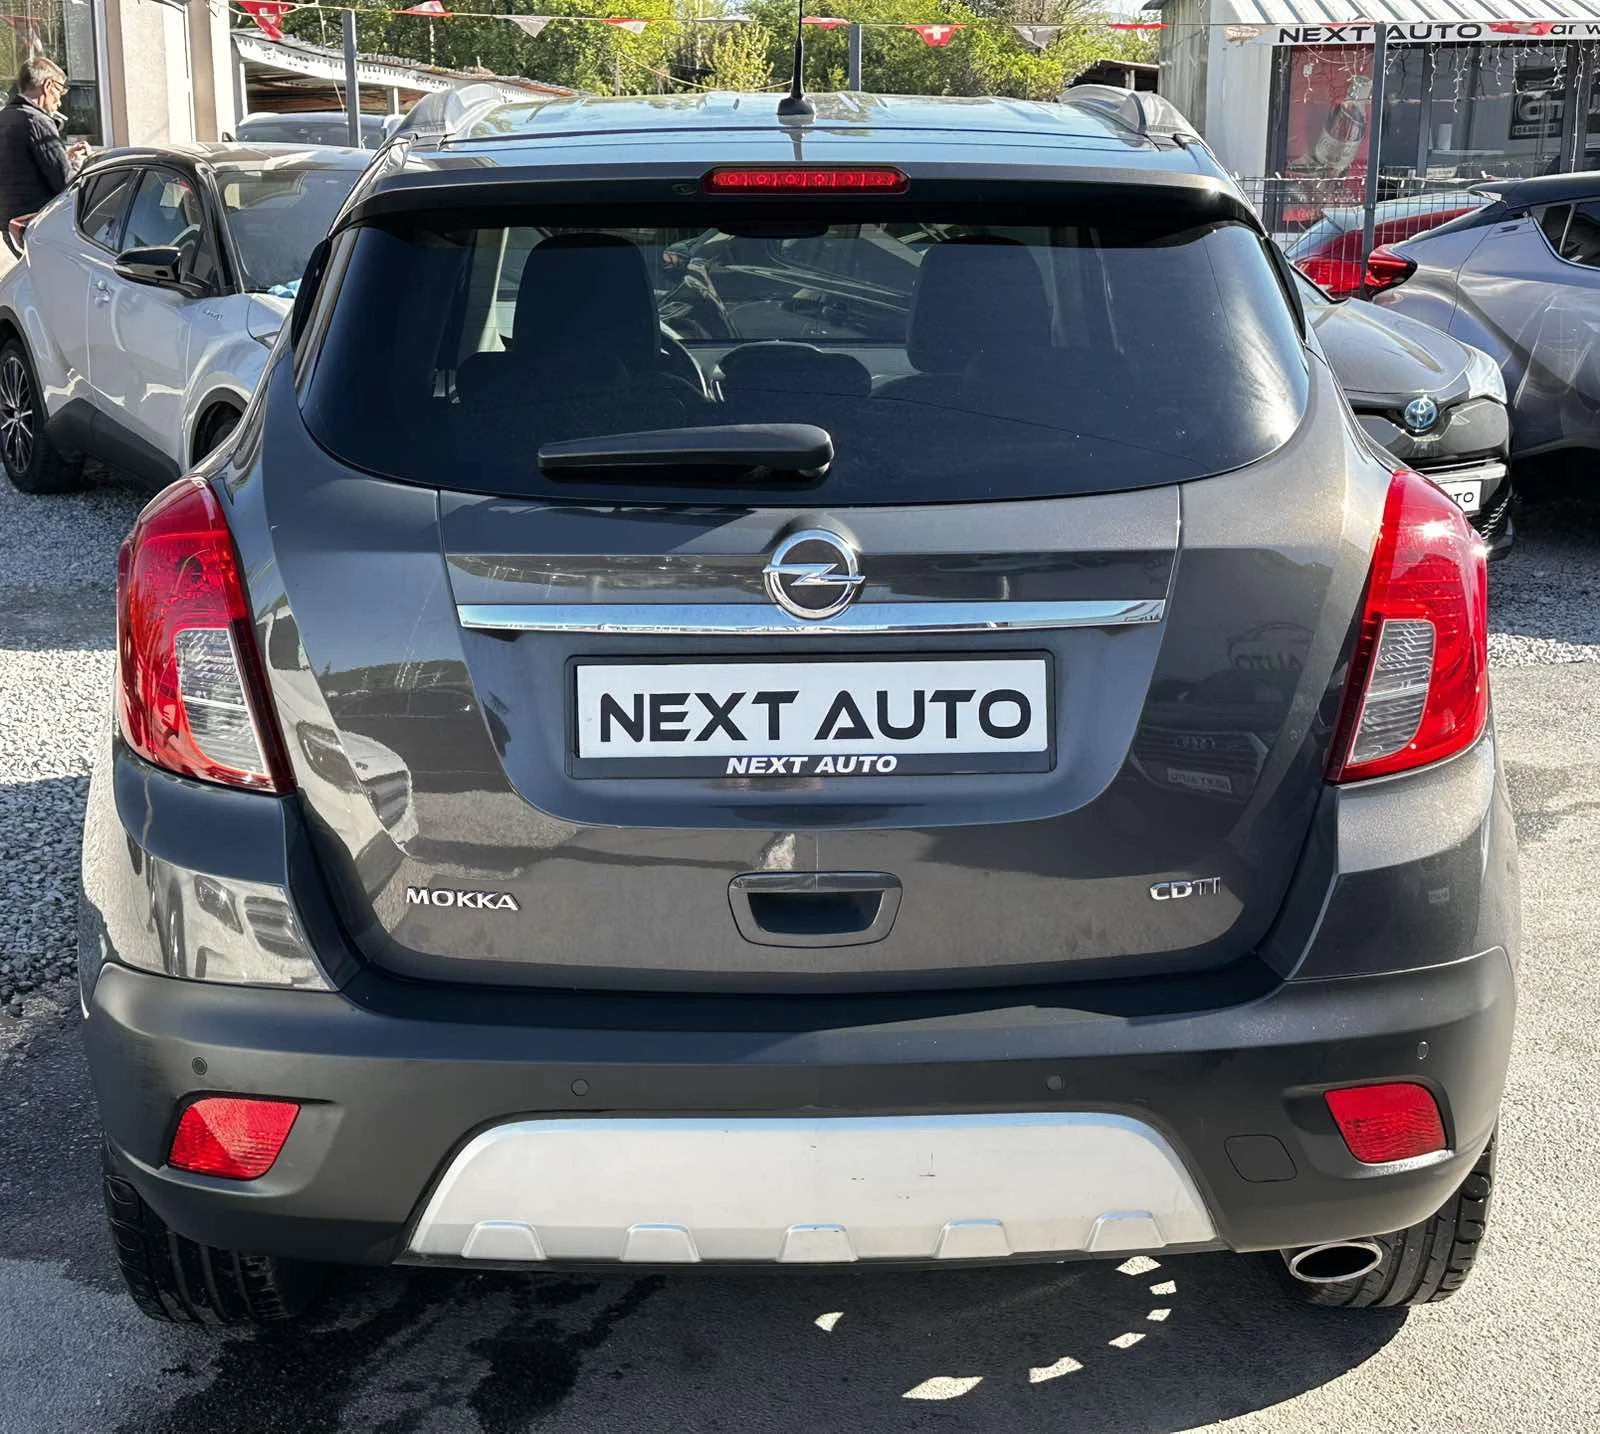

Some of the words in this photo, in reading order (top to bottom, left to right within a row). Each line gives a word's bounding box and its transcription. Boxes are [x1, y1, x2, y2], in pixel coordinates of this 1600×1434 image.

[1279, 26, 1371, 43] NEXT
[1386, 24, 1482, 40] AUTO
[600, 690, 799, 742] NEXT
[814, 688, 1032, 740] AUTO
[725, 757, 809, 774] NEXT
[814, 755, 898, 773] AUTO
[406, 887, 520, 911] MOKKA
[1150, 877, 1221, 900] CDTI
